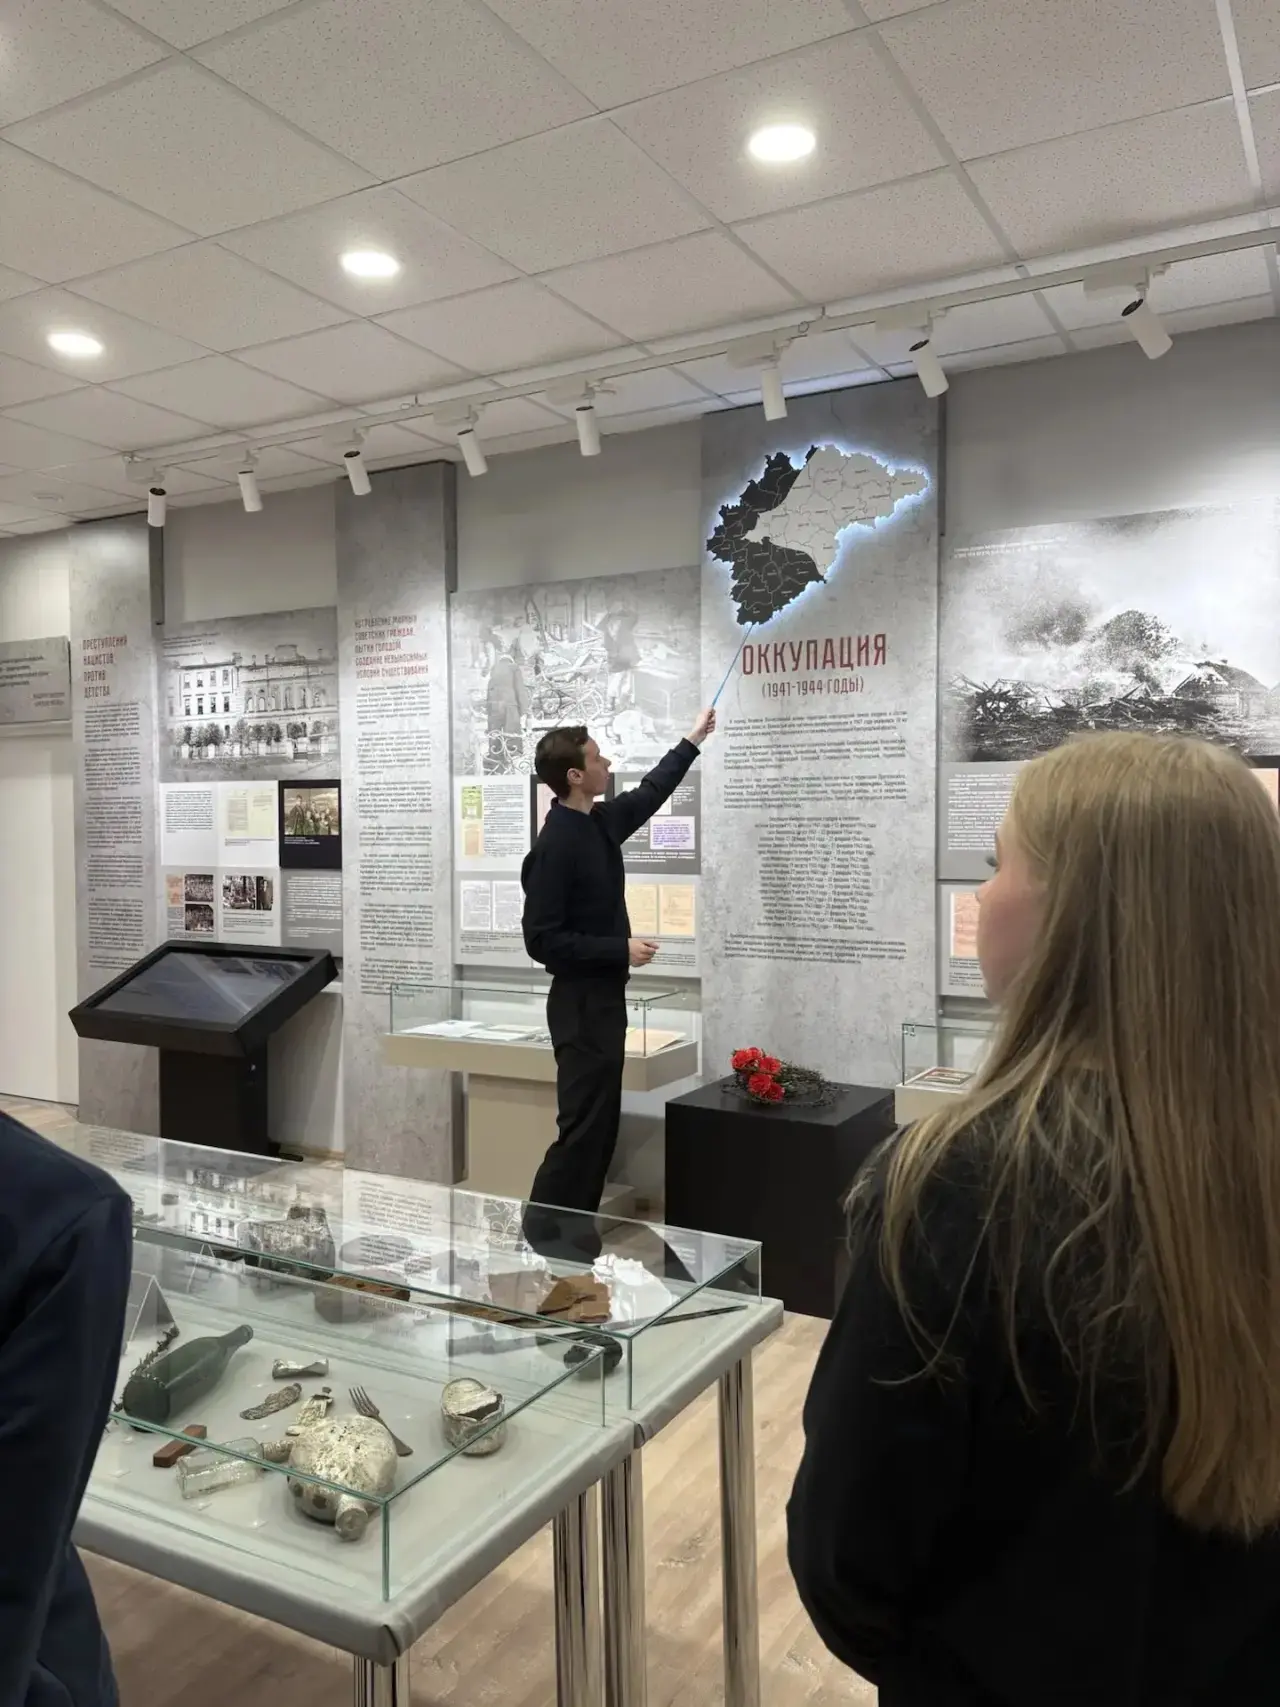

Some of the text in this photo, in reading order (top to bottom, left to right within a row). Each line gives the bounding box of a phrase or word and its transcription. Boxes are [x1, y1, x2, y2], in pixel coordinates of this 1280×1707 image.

[742, 633, 887, 675] ОККУПАЦИЯ
[84, 669, 106, 681] ПРОТИВ
[84, 685, 110, 698] ДЕТСТВА
[761, 676, 864, 698] (1941-1944 ГОДЫ)
